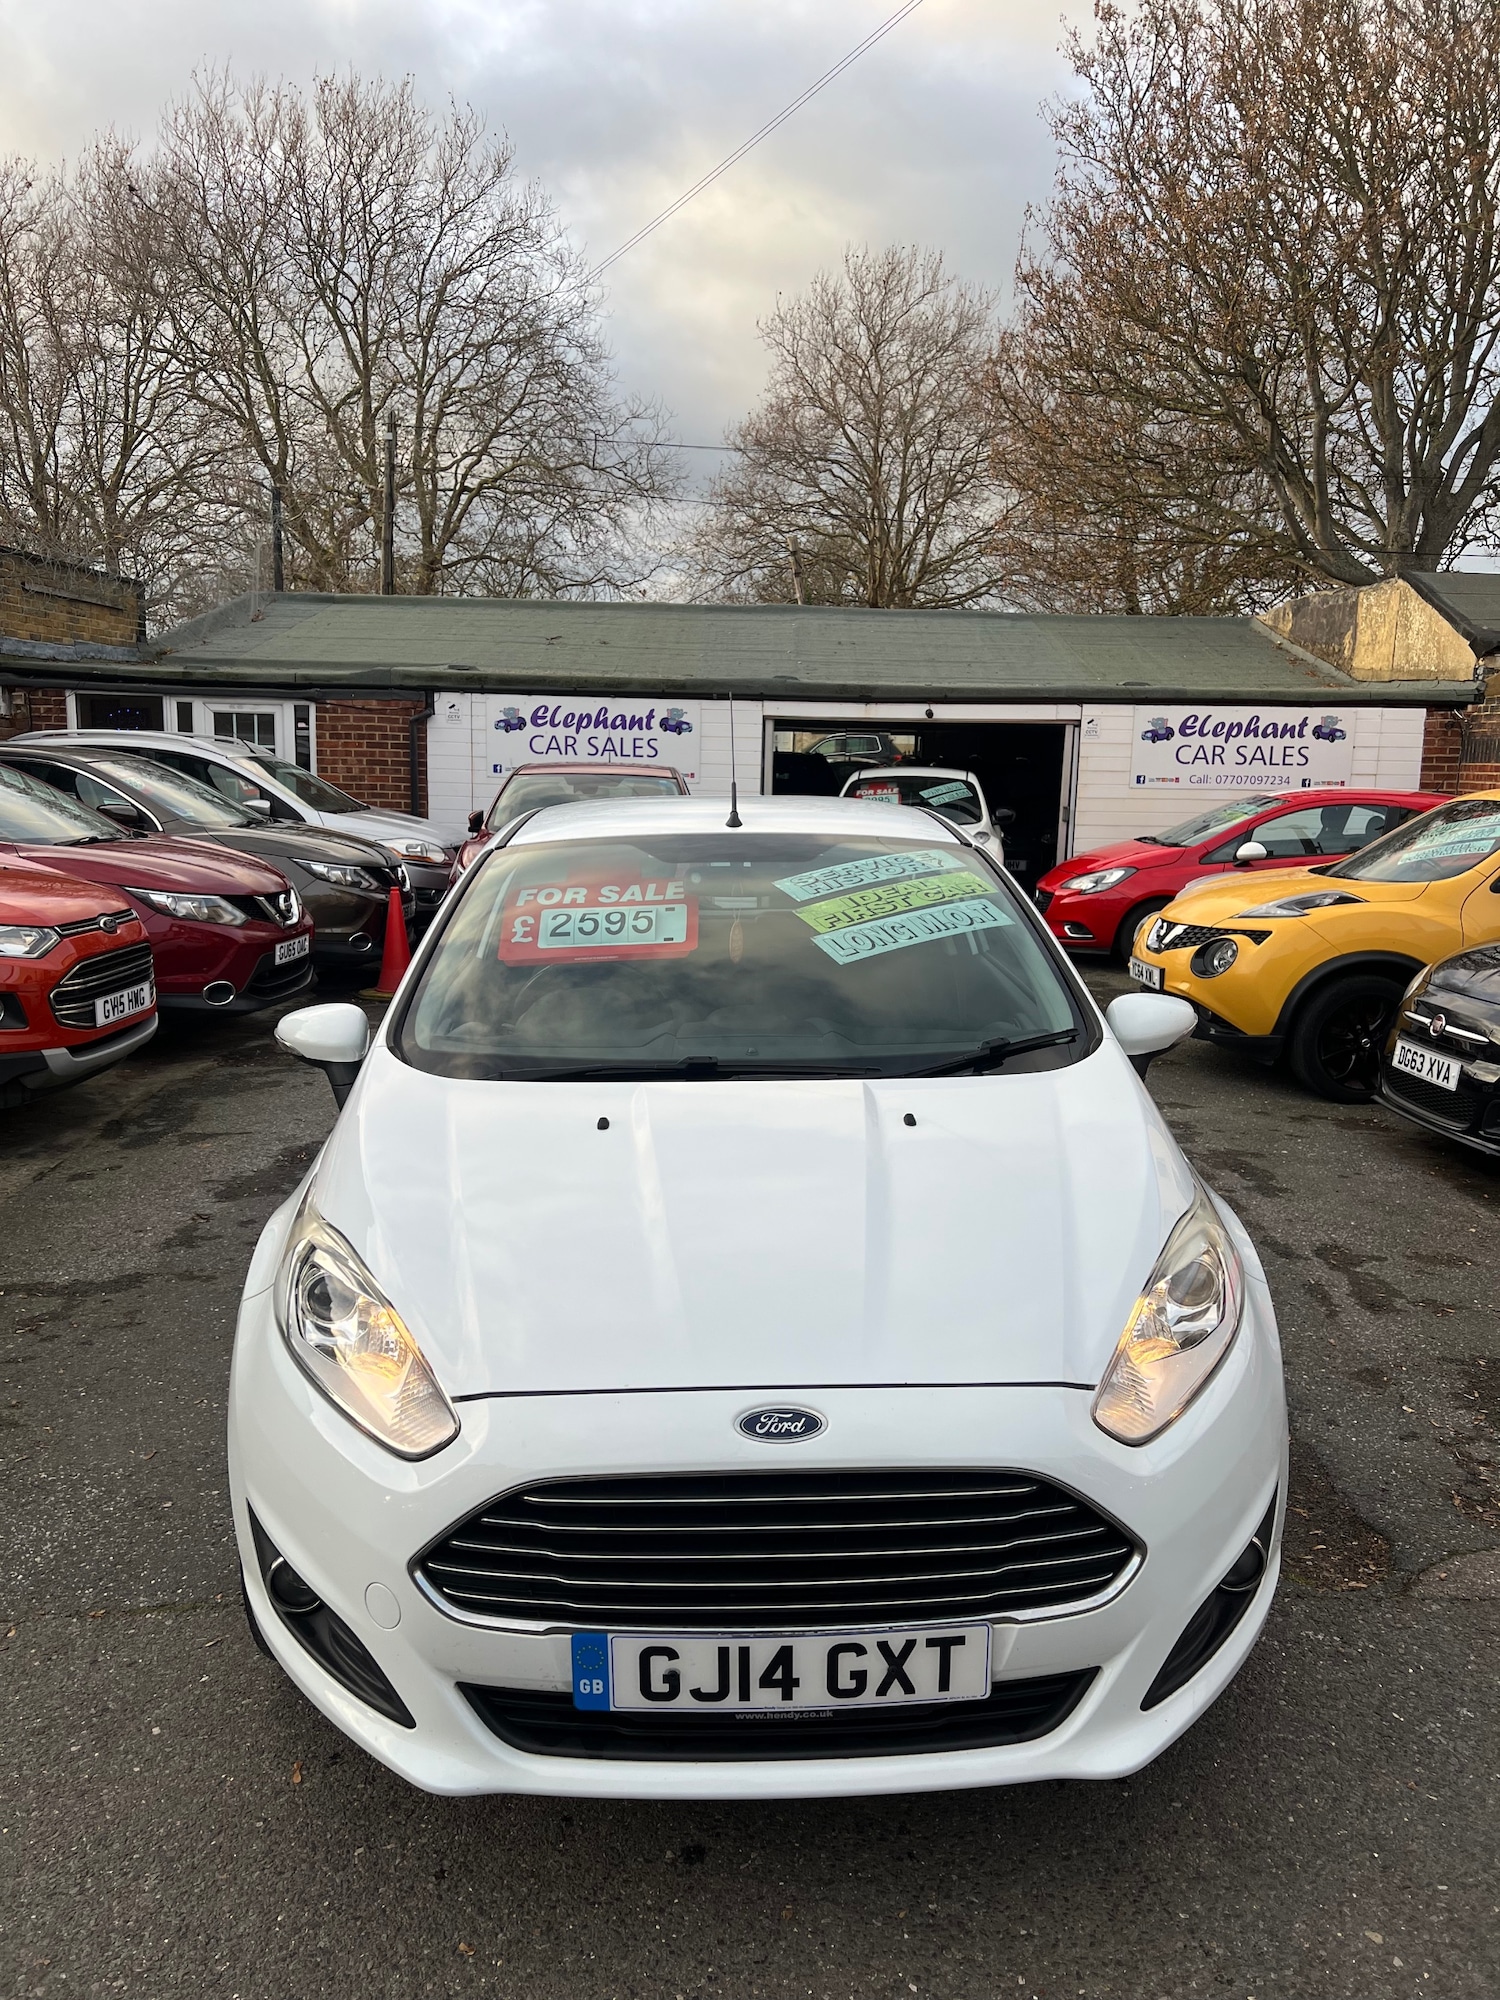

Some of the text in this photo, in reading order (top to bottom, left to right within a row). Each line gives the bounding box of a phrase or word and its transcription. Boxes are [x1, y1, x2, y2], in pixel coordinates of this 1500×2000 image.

[530, 704, 655, 734] Elephant
[1178, 714, 1309, 743] Elephant
[528, 734, 659, 758] CAR SALES
[1175, 744, 1309, 766] CAR SALES
[875, 787, 899, 795] SALE
[1189, 774, 1212, 785] Call:
[1215, 774, 1290, 785] 07707097234
[515, 881, 685, 907] FOR SALE
[814, 882, 990, 929] FIRST CAR
[839, 880, 940, 908] IDEAL
[510, 910, 654, 944] £ 2595
[821, 916, 919, 958] LONG
[1398, 1045, 1451, 1084] DG63 XVA
[755, 1412, 806, 1434] Ford
[638, 1635, 966, 1702] GJ14 GXT
[579, 1679, 604, 1694] GB
[735, 1709, 834, 1720] www.hendy.co.uk
